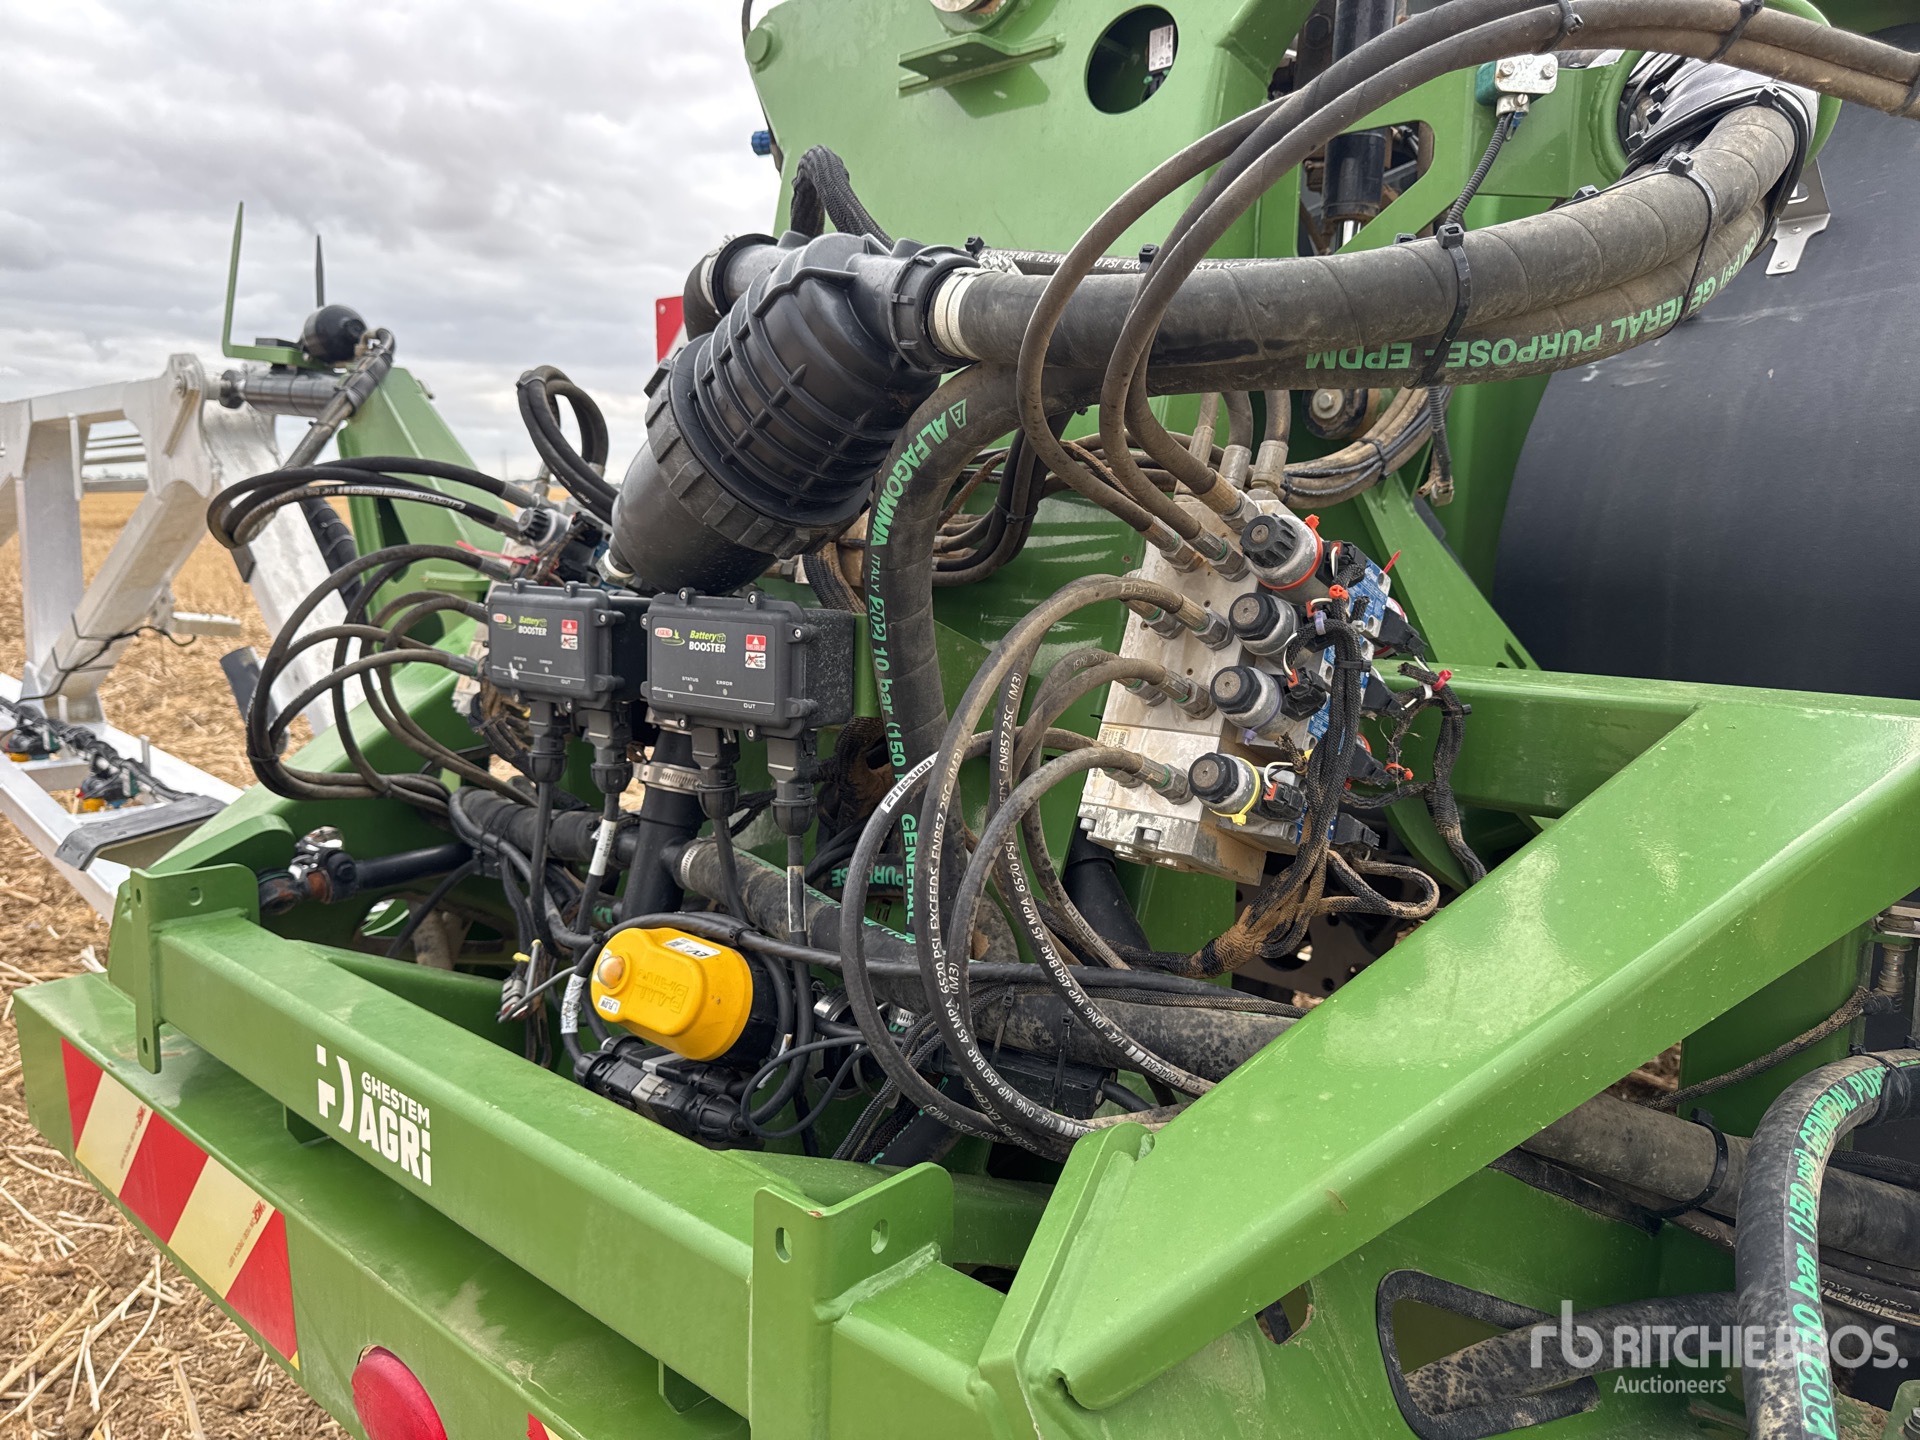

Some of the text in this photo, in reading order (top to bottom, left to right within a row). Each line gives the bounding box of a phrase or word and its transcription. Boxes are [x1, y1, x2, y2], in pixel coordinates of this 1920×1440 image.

[1306, 343, 1412, 370] EPDM
[1446, 324, 1603, 368] PURPOSE
[870, 411, 949, 546] ALFAGOMMA
[870, 554, 881, 592] ITALY
[518, 625, 547, 636] BOOSTER
[519, 616, 540, 626] Battery
[868, 595, 887, 642] 202
[688, 641, 726, 653] BOOSTER
[690, 630, 717, 643] Battery
[872, 646, 890, 671] 10
[880, 678, 894, 715] bar
[1007, 672, 1024, 700] (M3)
[1002, 705, 1016, 732] 2SC
[886, 722, 907, 767] (150
[998, 732, 1014, 774] EN857
[948, 748, 963, 780] (M3)
[940, 783, 953, 812] 2SC
[931, 812, 946, 860] EN857
[1006, 841, 1018, 860] PSI
[1011, 864, 1026, 892] 6520
[928, 867, 940, 930] EXCEEDS
[1022, 897, 1038, 926] MPA
[931, 937, 944, 959] PSI
[1032, 926, 1045, 942] 45
[1040, 944, 1059, 970] BAR
[935, 961, 950, 994] 6520
[949, 962, 960, 995] (M3)
[1068, 989, 1086, 1007] WP
[945, 998, 962, 1029] MPA
[1084, 1006, 1106, 1029] DN6
[956, 1028, 970, 1044] 45
[967, 1047, 986, 1071] BAR
[1145, 1058, 1181, 1085] H204E-04
[982, 1068, 1000, 1087] 450
[361, 1071, 431, 1129] GHESTEM
[997, 1085, 1015, 1101] WP
[923, 1103, 950, 1121] (M3)
[1014, 1097, 1036, 1118] DN6
[1799, 1084, 1858, 1158] GENERAL
[1788, 1182, 1816, 1243] (150
[1790, 1243, 1819, 1303] bar
[1793, 1303, 1824, 1347] 10
[1796, 1352, 1838, 1440] 202
